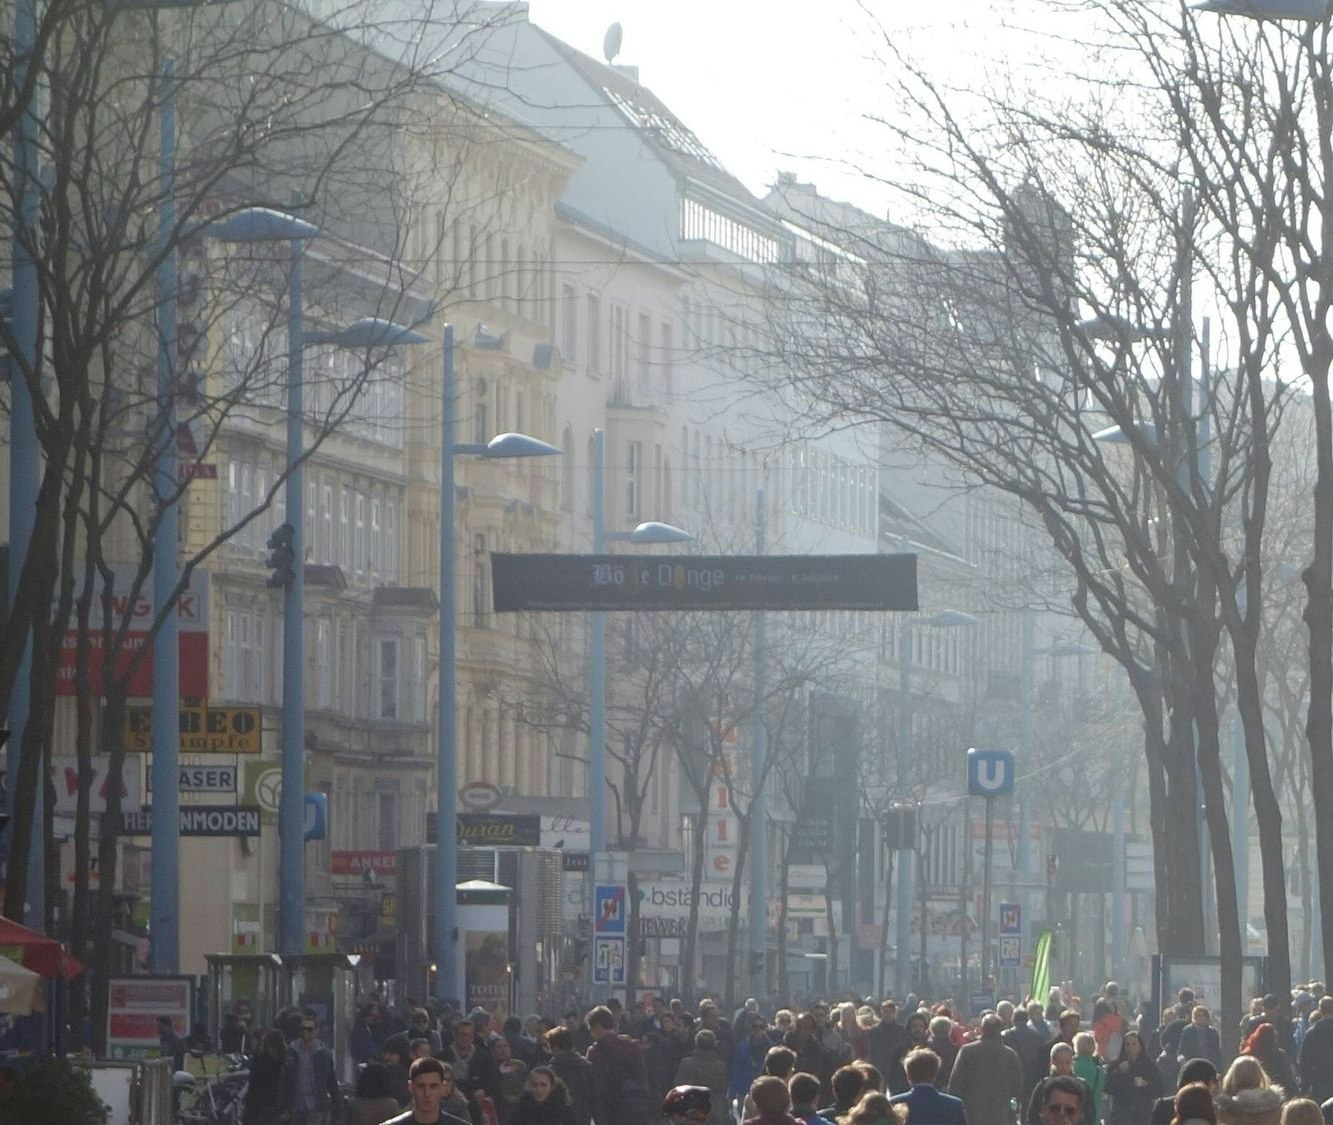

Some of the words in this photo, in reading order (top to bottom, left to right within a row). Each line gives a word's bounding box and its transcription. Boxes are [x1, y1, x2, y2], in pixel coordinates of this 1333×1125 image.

[593, 564, 650, 584] Böe
[659, 564, 725, 590] Dnge
[978, 759, 1004, 790] U
